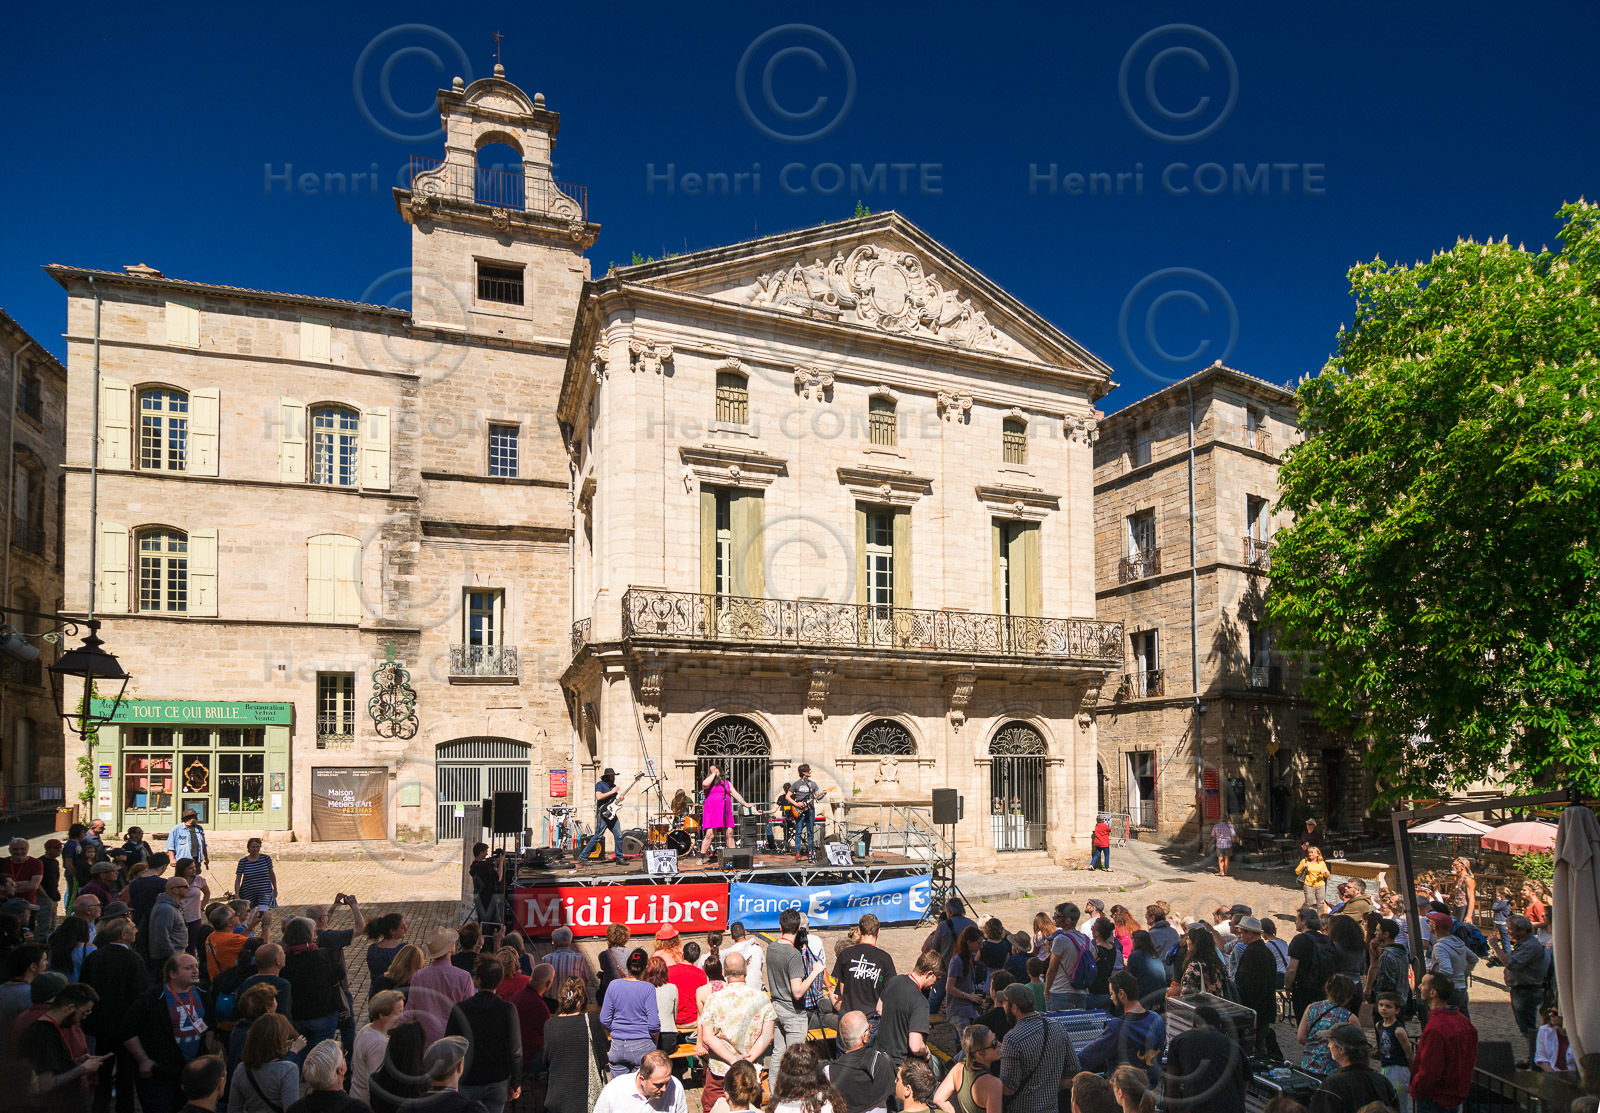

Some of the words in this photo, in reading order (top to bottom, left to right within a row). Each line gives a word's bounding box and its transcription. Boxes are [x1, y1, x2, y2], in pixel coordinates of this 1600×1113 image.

[132, 706, 162, 718] TOUT
[165, 706, 180, 718] CE
[182, 706, 203, 719] QUI
[245, 703, 285, 711] Restauration
[355, 800, 372, 808] d'Art
[738, 894, 802, 913] france
[846, 891, 903, 908] france
[524, 896, 612, 928] Midi
[624, 894, 720, 925] Libre
